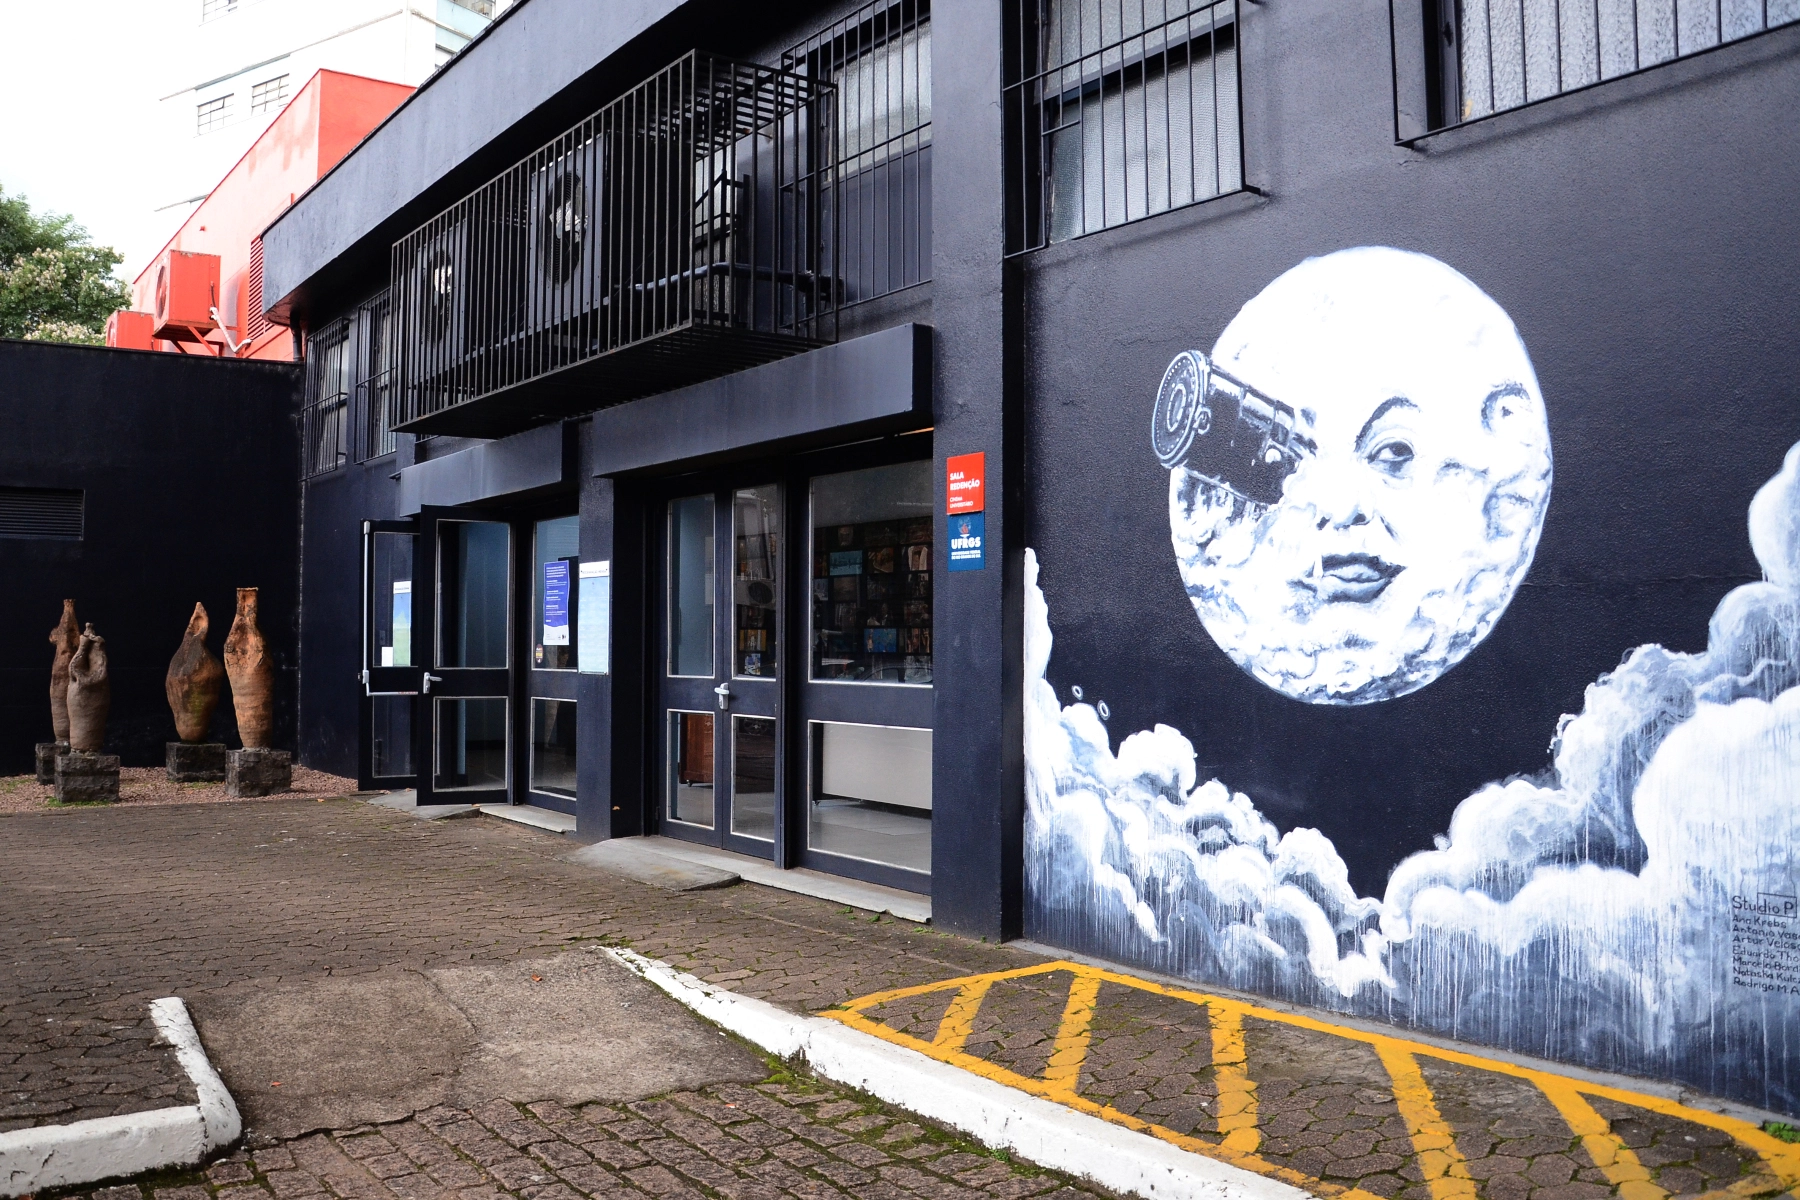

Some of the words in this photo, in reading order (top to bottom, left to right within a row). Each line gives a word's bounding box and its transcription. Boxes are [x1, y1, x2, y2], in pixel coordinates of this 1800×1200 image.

[950, 472, 964, 480] SALA
[950, 478, 980, 490] REDENÇÃO
[951, 537, 981, 549] UFRGS
[1732, 896, 1780, 914] Studio
[1783, 900, 1794, 915] P
[1732, 914, 1752, 925] Ana
[1754, 915, 1786, 928] Krebs
[1732, 934, 1764, 946] Artur
[1732, 945, 1776, 960] Eduardo
[1732, 966, 1774, 980] Natasha
[1733, 976, 1774, 992] Rodrigo
